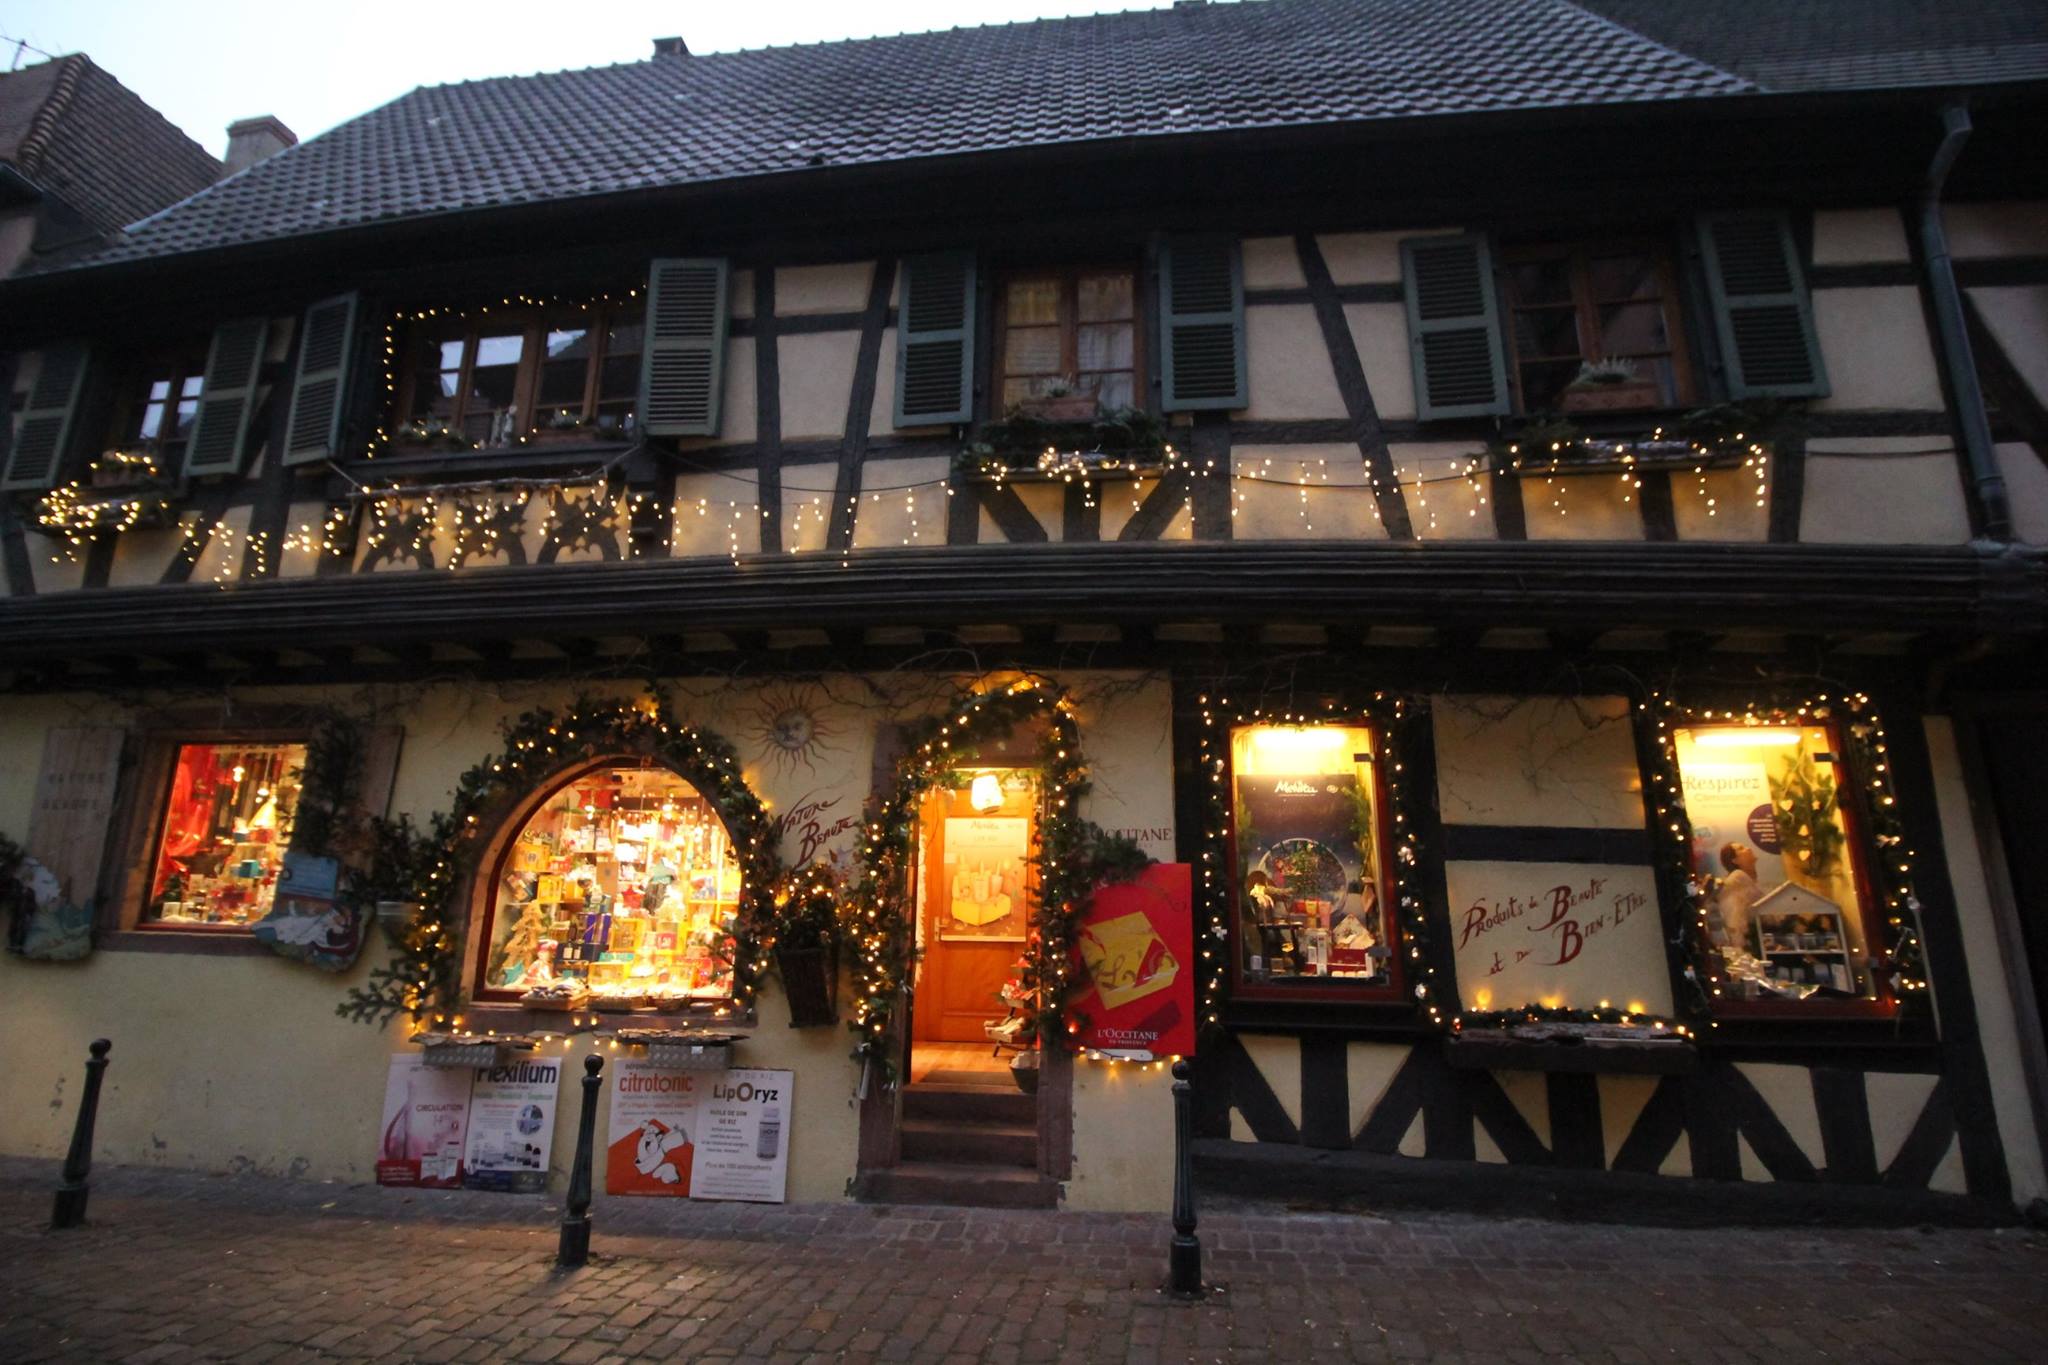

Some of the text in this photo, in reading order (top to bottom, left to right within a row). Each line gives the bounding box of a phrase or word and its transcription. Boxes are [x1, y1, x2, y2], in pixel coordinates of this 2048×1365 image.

[1683, 776, 1760, 793] Respirez
[1097, 1027, 1160, 1041] L'OCCITANE
[619, 1071, 694, 1093] citrotonic
[713, 1082, 779, 1104] LipOryz
